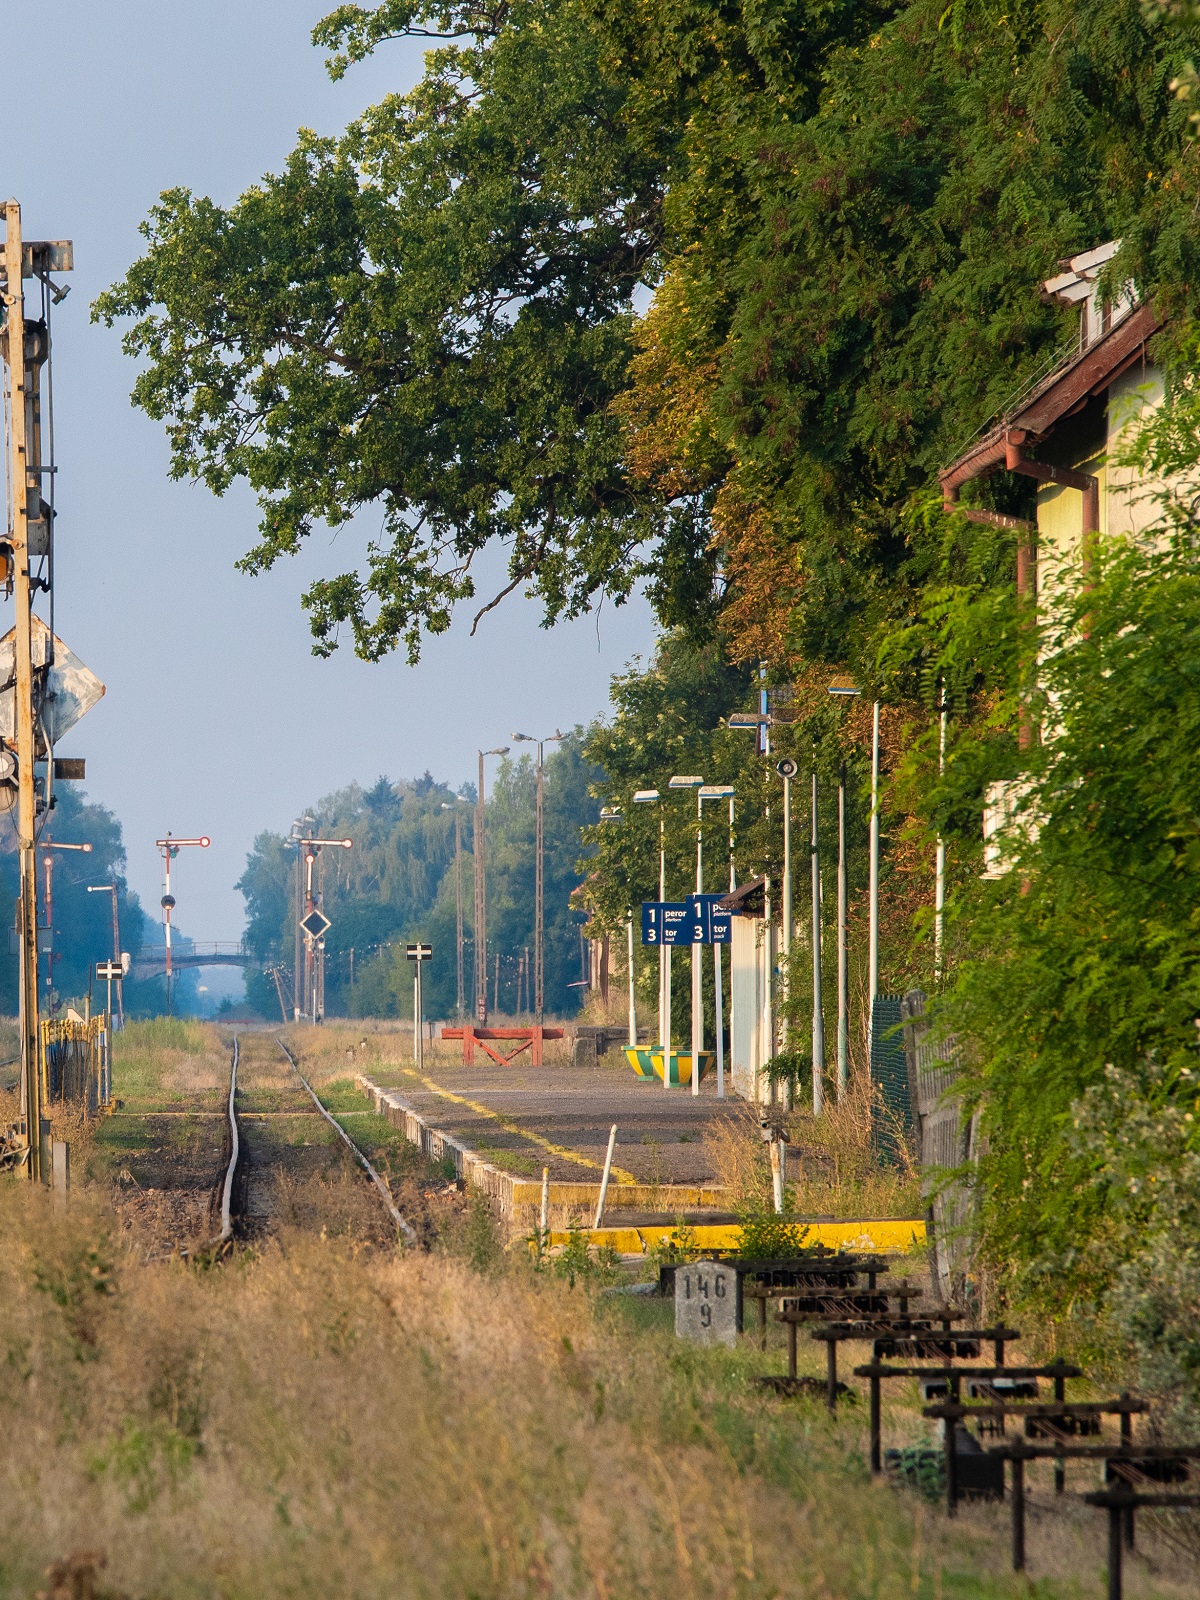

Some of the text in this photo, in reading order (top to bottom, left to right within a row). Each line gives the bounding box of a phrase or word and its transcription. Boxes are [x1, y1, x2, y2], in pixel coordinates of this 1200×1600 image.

[649, 909, 656, 923] 1
[694, 902, 701, 918] 1
[647, 929, 656, 941] 3
[694, 925, 703, 940] 3
[713, 925, 728, 933] tor
[684, 1274, 726, 1299] 146
[700, 1303, 712, 1328] 9
